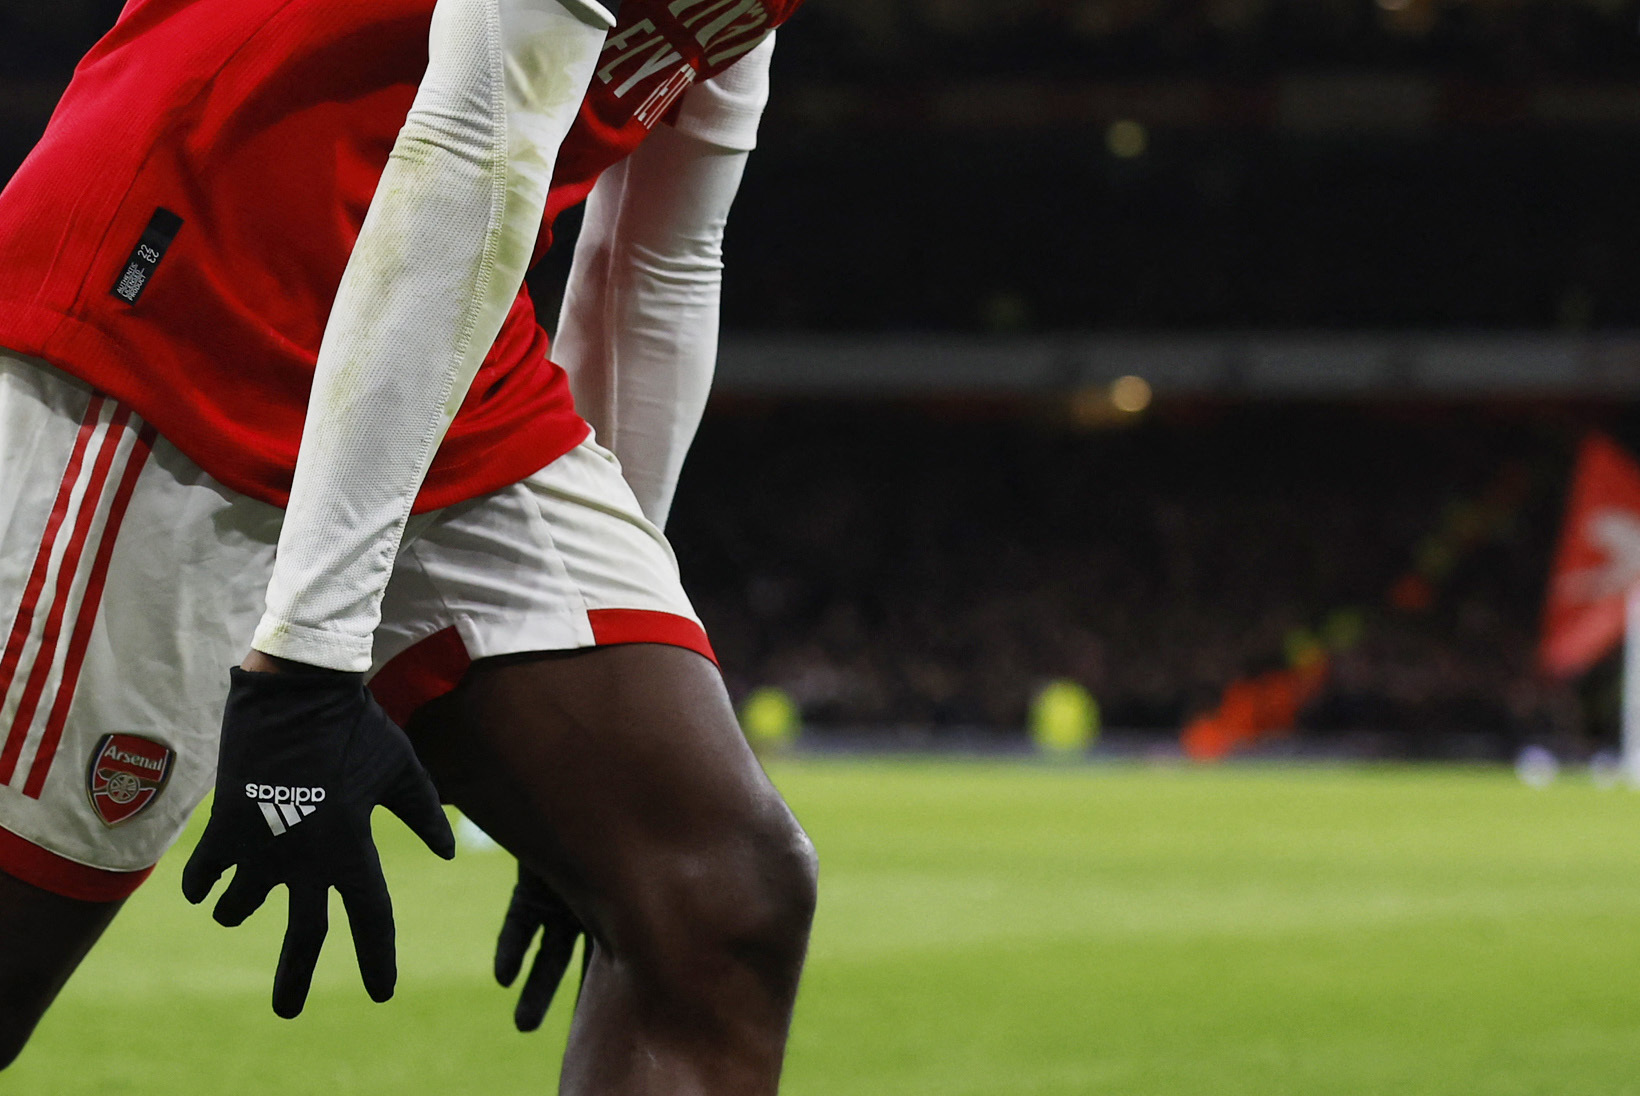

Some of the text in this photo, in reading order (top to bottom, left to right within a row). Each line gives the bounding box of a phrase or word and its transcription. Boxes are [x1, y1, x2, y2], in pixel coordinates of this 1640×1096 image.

[597, 18, 682, 99] FLY
[137, 244, 150, 259] 22
[117, 262, 138, 294] AUTHENTIC
[128, 273, 147, 301] PRODUCT
[104, 745, 163, 771] Arsenal
[245, 783, 326, 805] adidas
